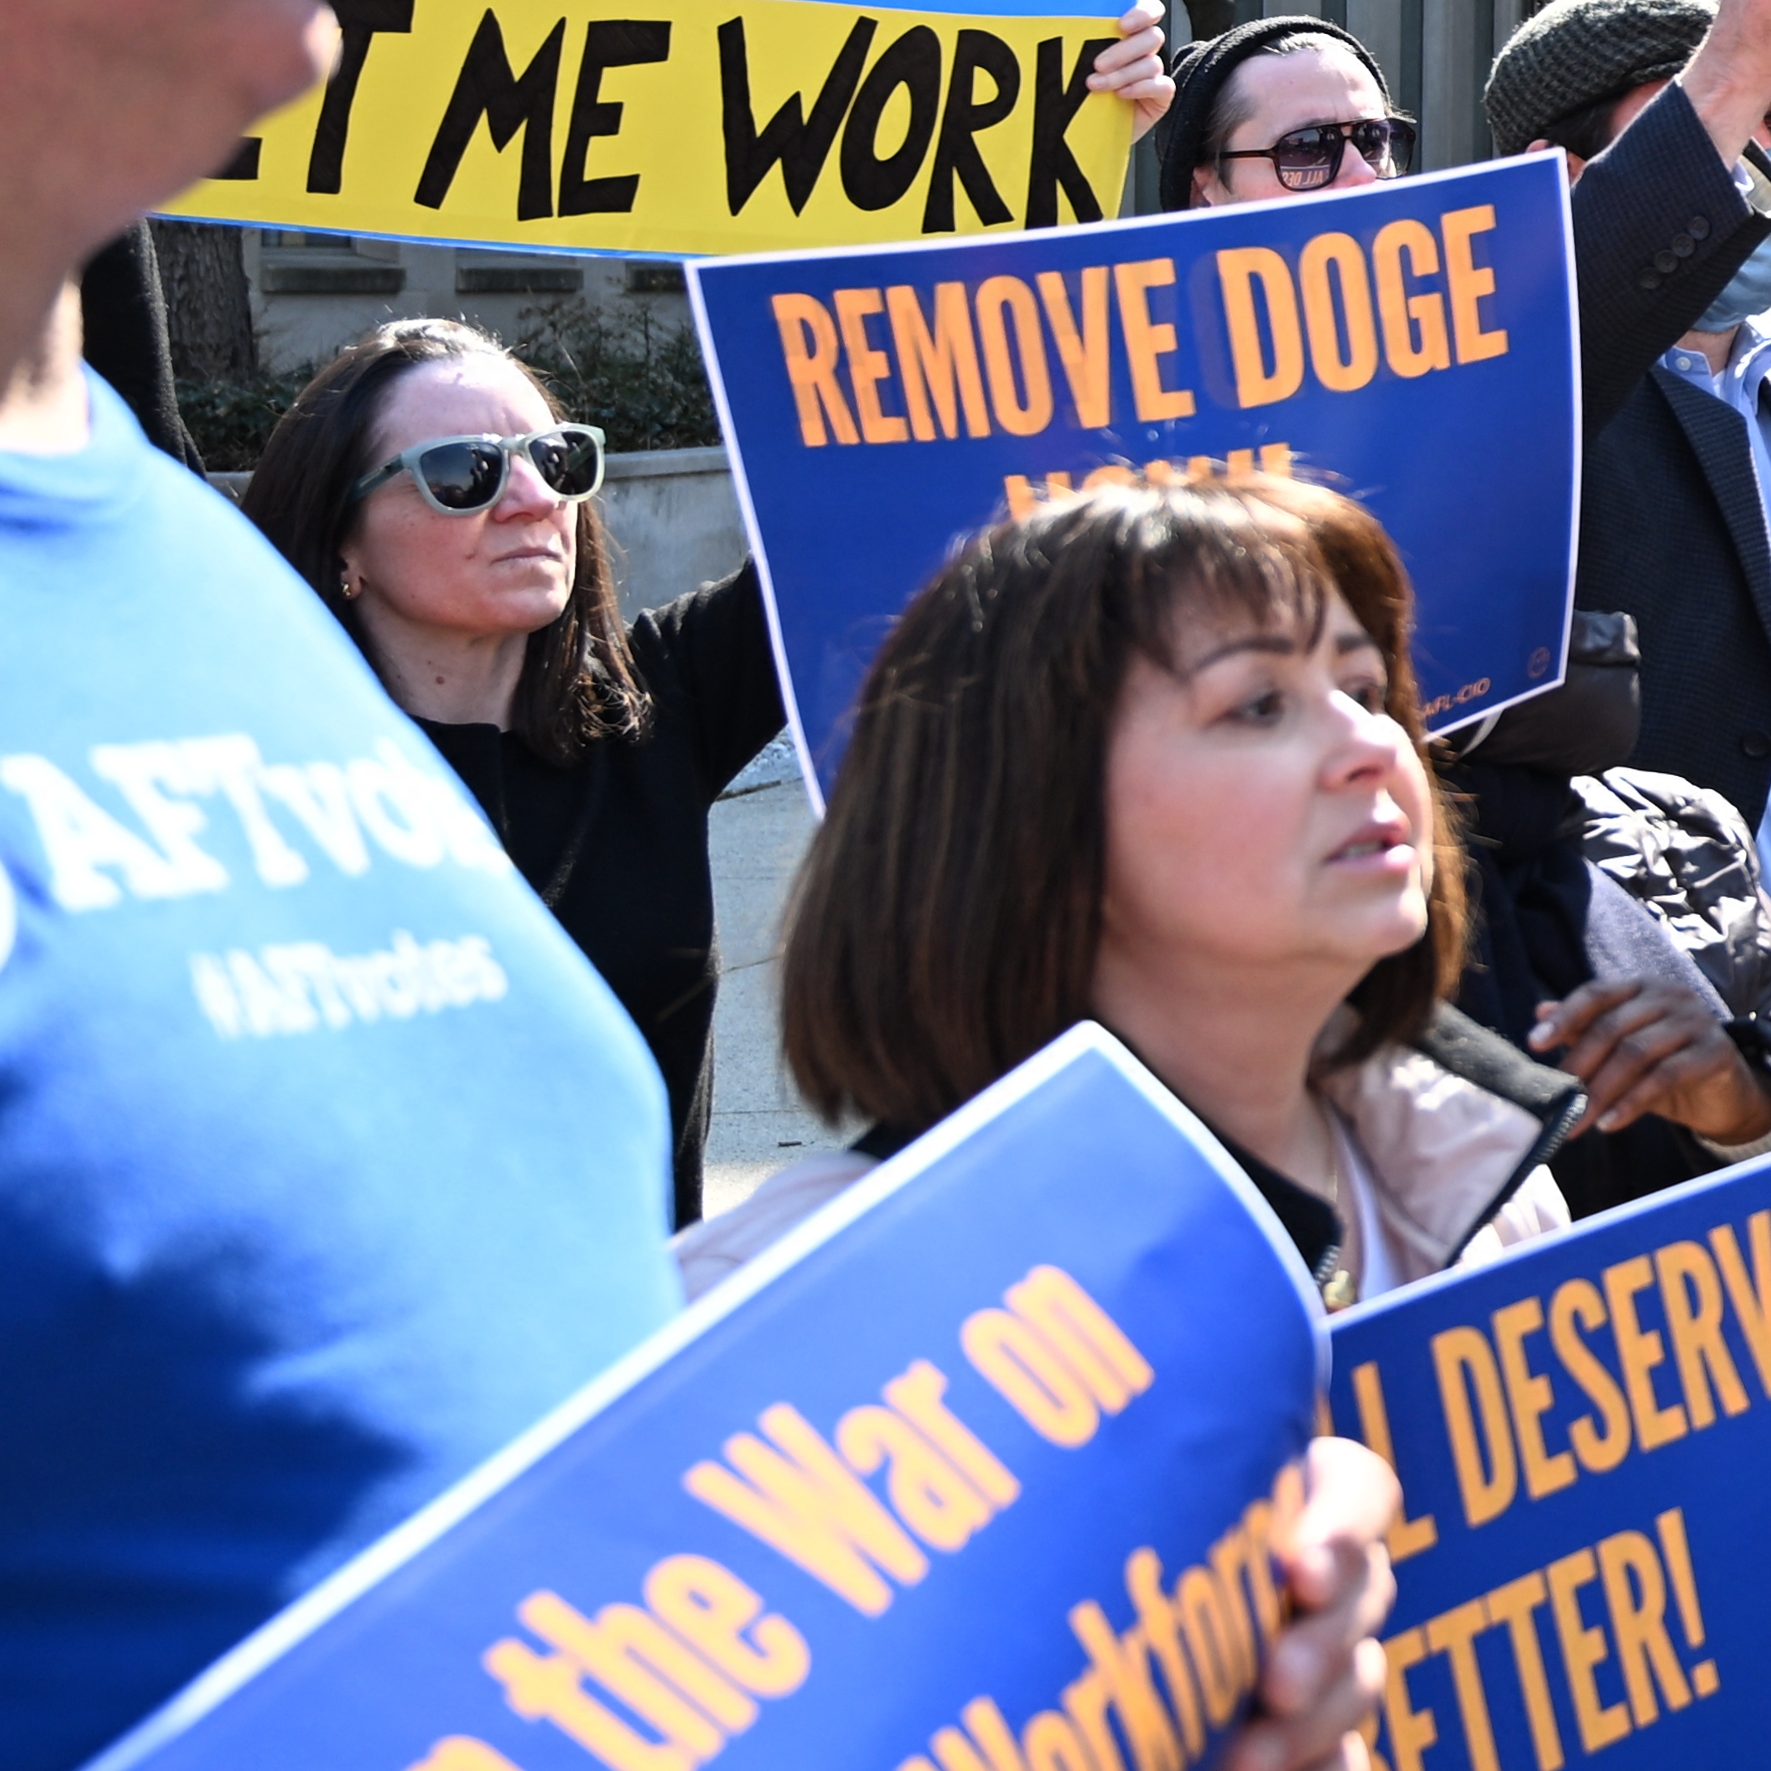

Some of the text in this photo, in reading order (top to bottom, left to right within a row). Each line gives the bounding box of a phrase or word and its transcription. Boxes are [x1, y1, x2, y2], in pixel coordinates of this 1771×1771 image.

[413, 7, 673, 222] ME
[715, 15, 1114, 235] WORK
[769, 203, 1509, 448] REMOVE DOGE
[480, 1263, 1157, 1771] the War on
